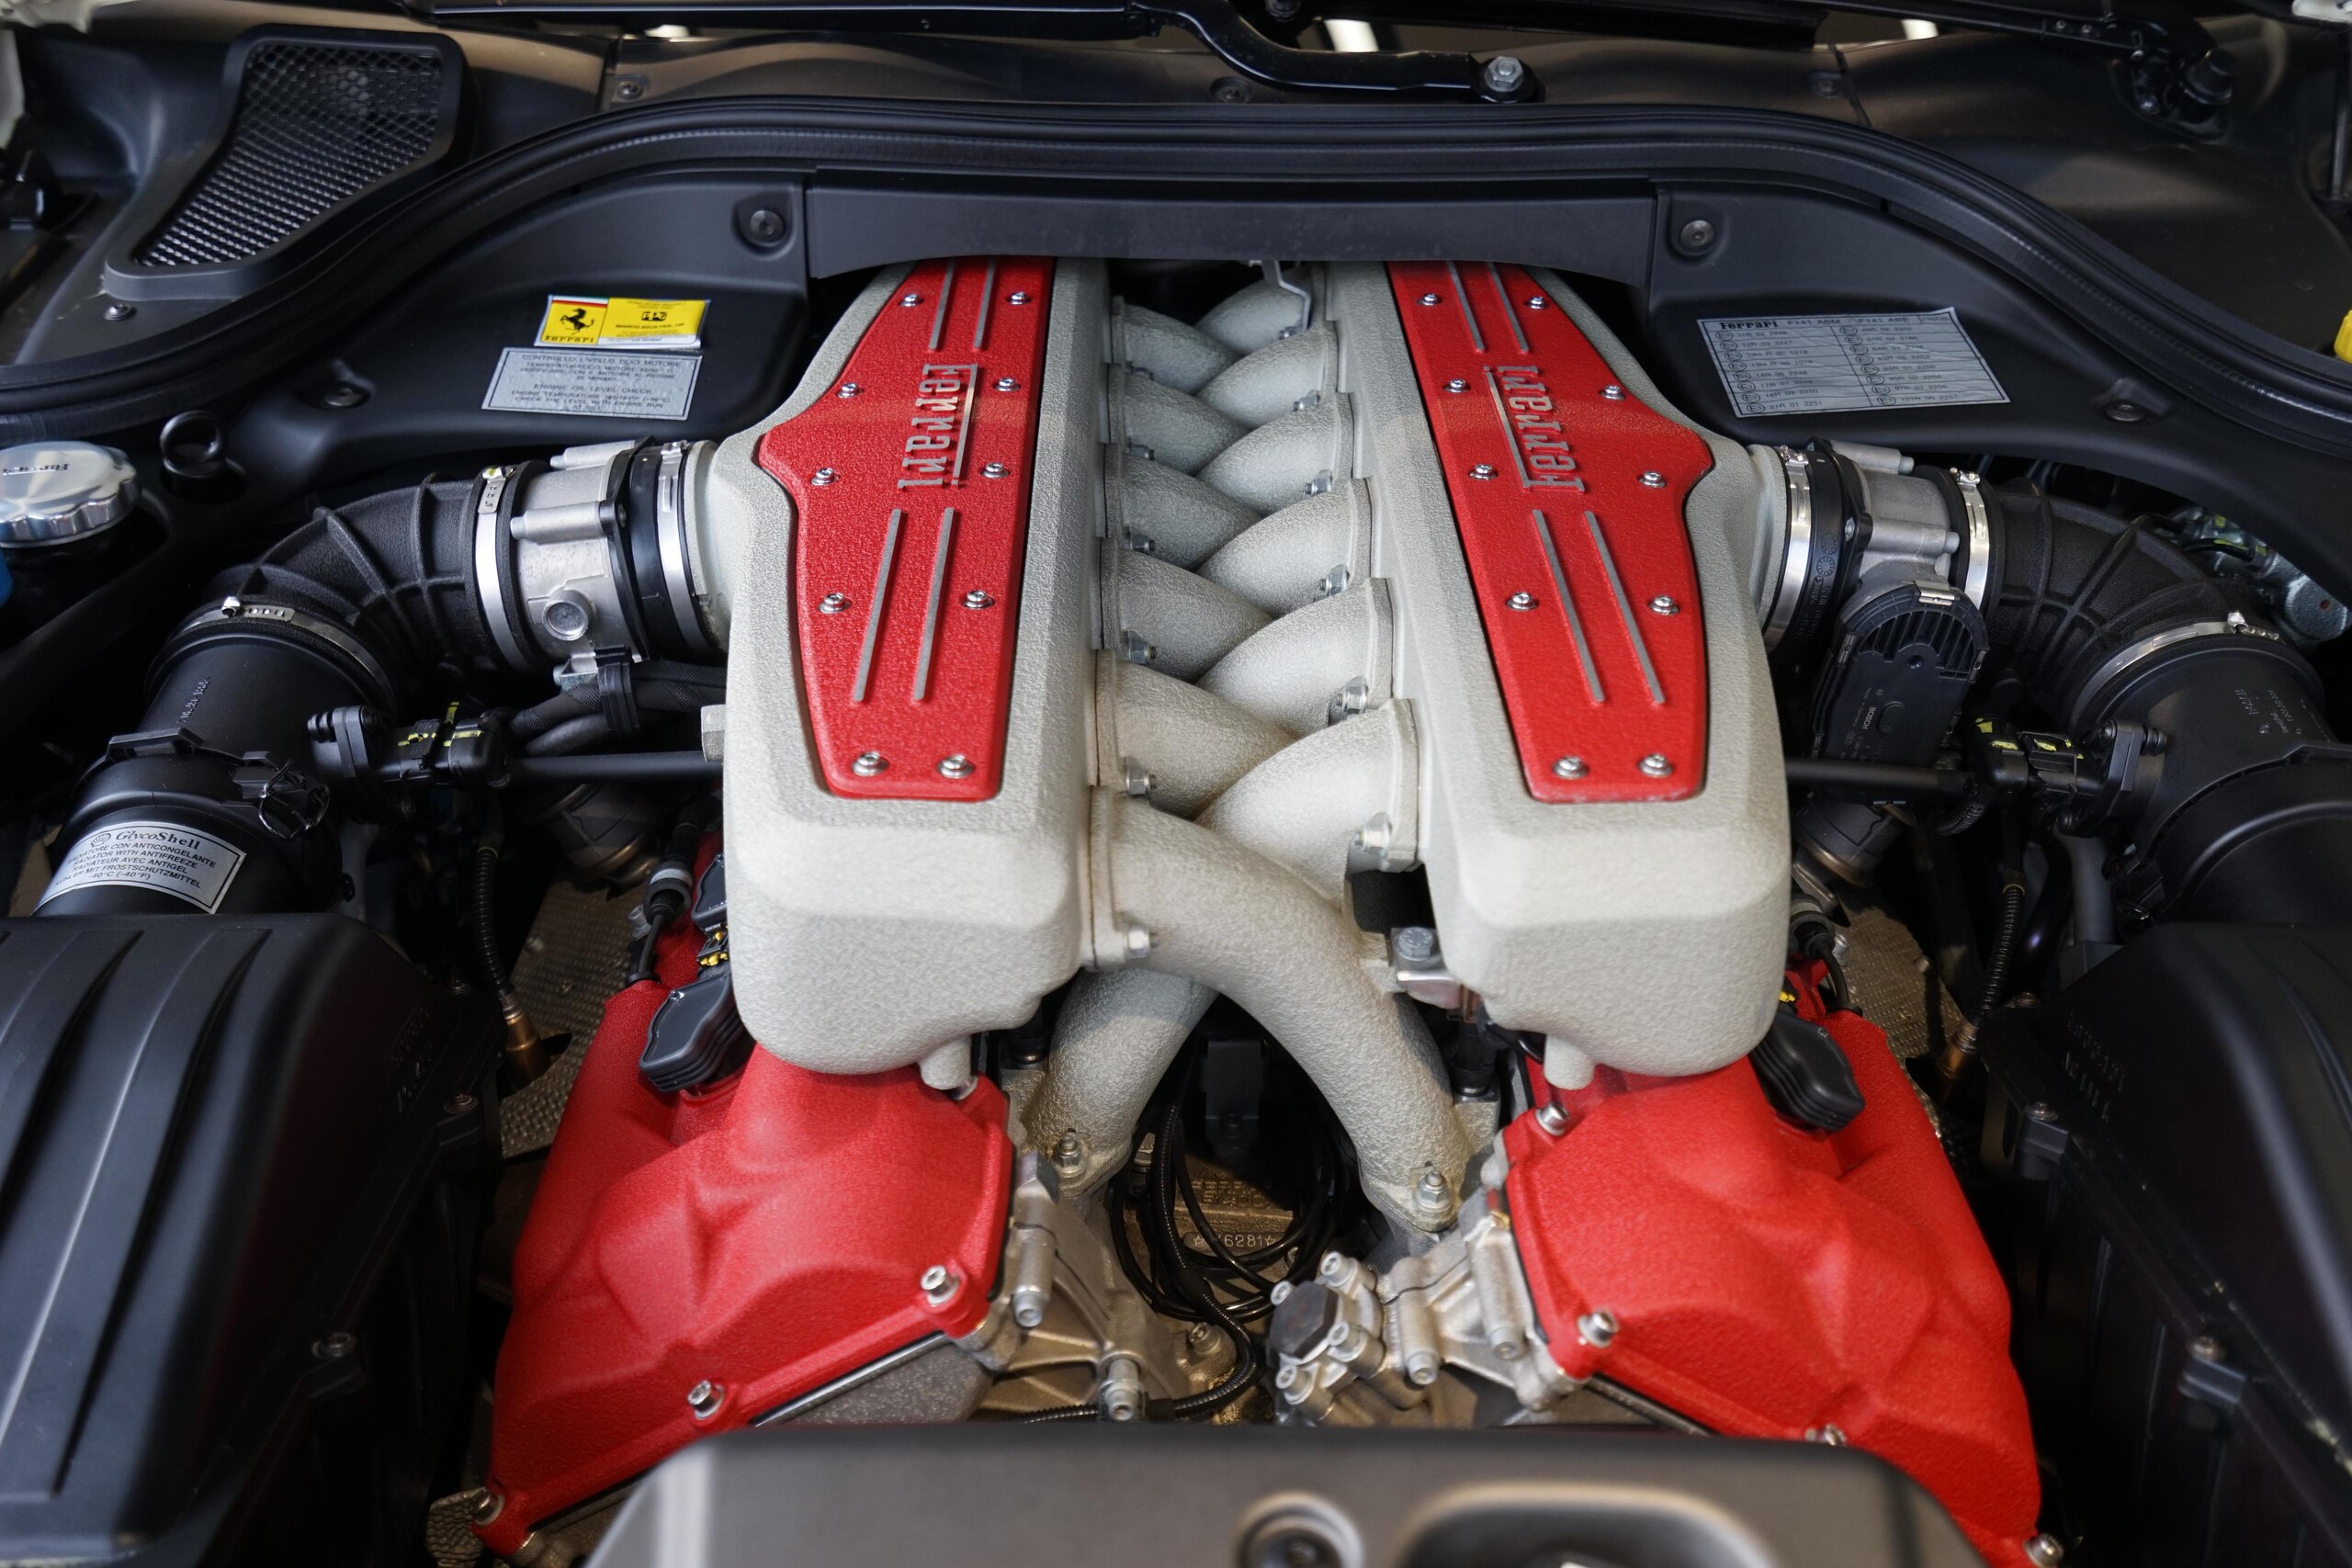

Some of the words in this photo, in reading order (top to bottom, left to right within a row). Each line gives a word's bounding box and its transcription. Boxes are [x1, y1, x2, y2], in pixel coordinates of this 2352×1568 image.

[1718, 320, 1779, 329] Ferrari
[897, 363, 979, 490] Ferrari
[1483, 365, 1586, 492] Ferrari
[1862, 706, 1876, 729] BOSCH
[116, 830, 201, 851] GlycoShell
[72, 857, 119, 873] RADIATEUR
[148, 859, 187, 874] ANTIGEL
[132, 842, 217, 868] ANTICONGELANTE
[141, 850, 198, 869] ANTIFREEZE
[101, 864, 201, 888] FROSTSCHUTZMITTEL
